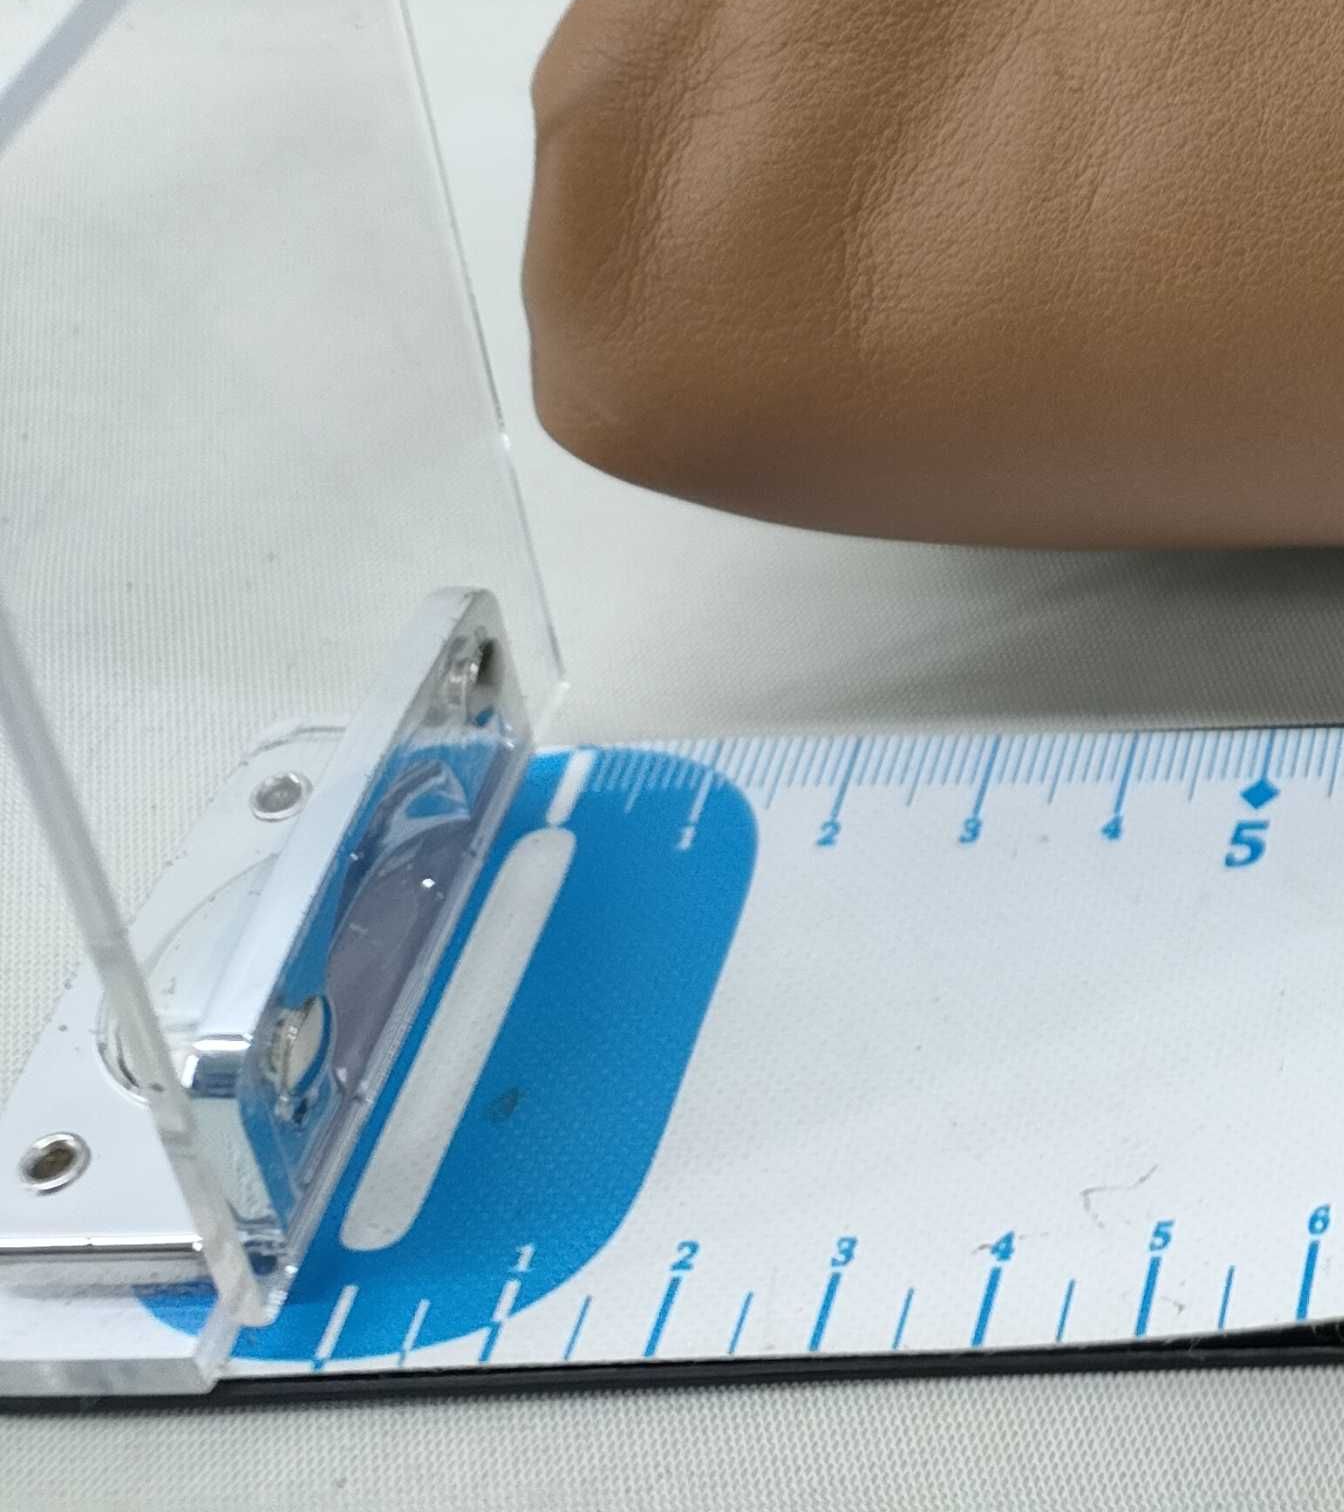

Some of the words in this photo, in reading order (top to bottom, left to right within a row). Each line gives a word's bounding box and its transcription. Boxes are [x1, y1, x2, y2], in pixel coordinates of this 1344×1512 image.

[816, 821, 841, 847] 2
[958, 818, 982, 844] 3
[1100, 816, 1123, 841] 4
[1224, 821, 1269, 868] 5
[512, 1244, 537, 1273] 1
[670, 1240, 700, 1272] 2
[830, 1236, 858, 1268] 3
[991, 1231, 1016, 1261] 4
[1148, 1220, 1175, 1251] 5
[1308, 1205, 1332, 1236] 6
